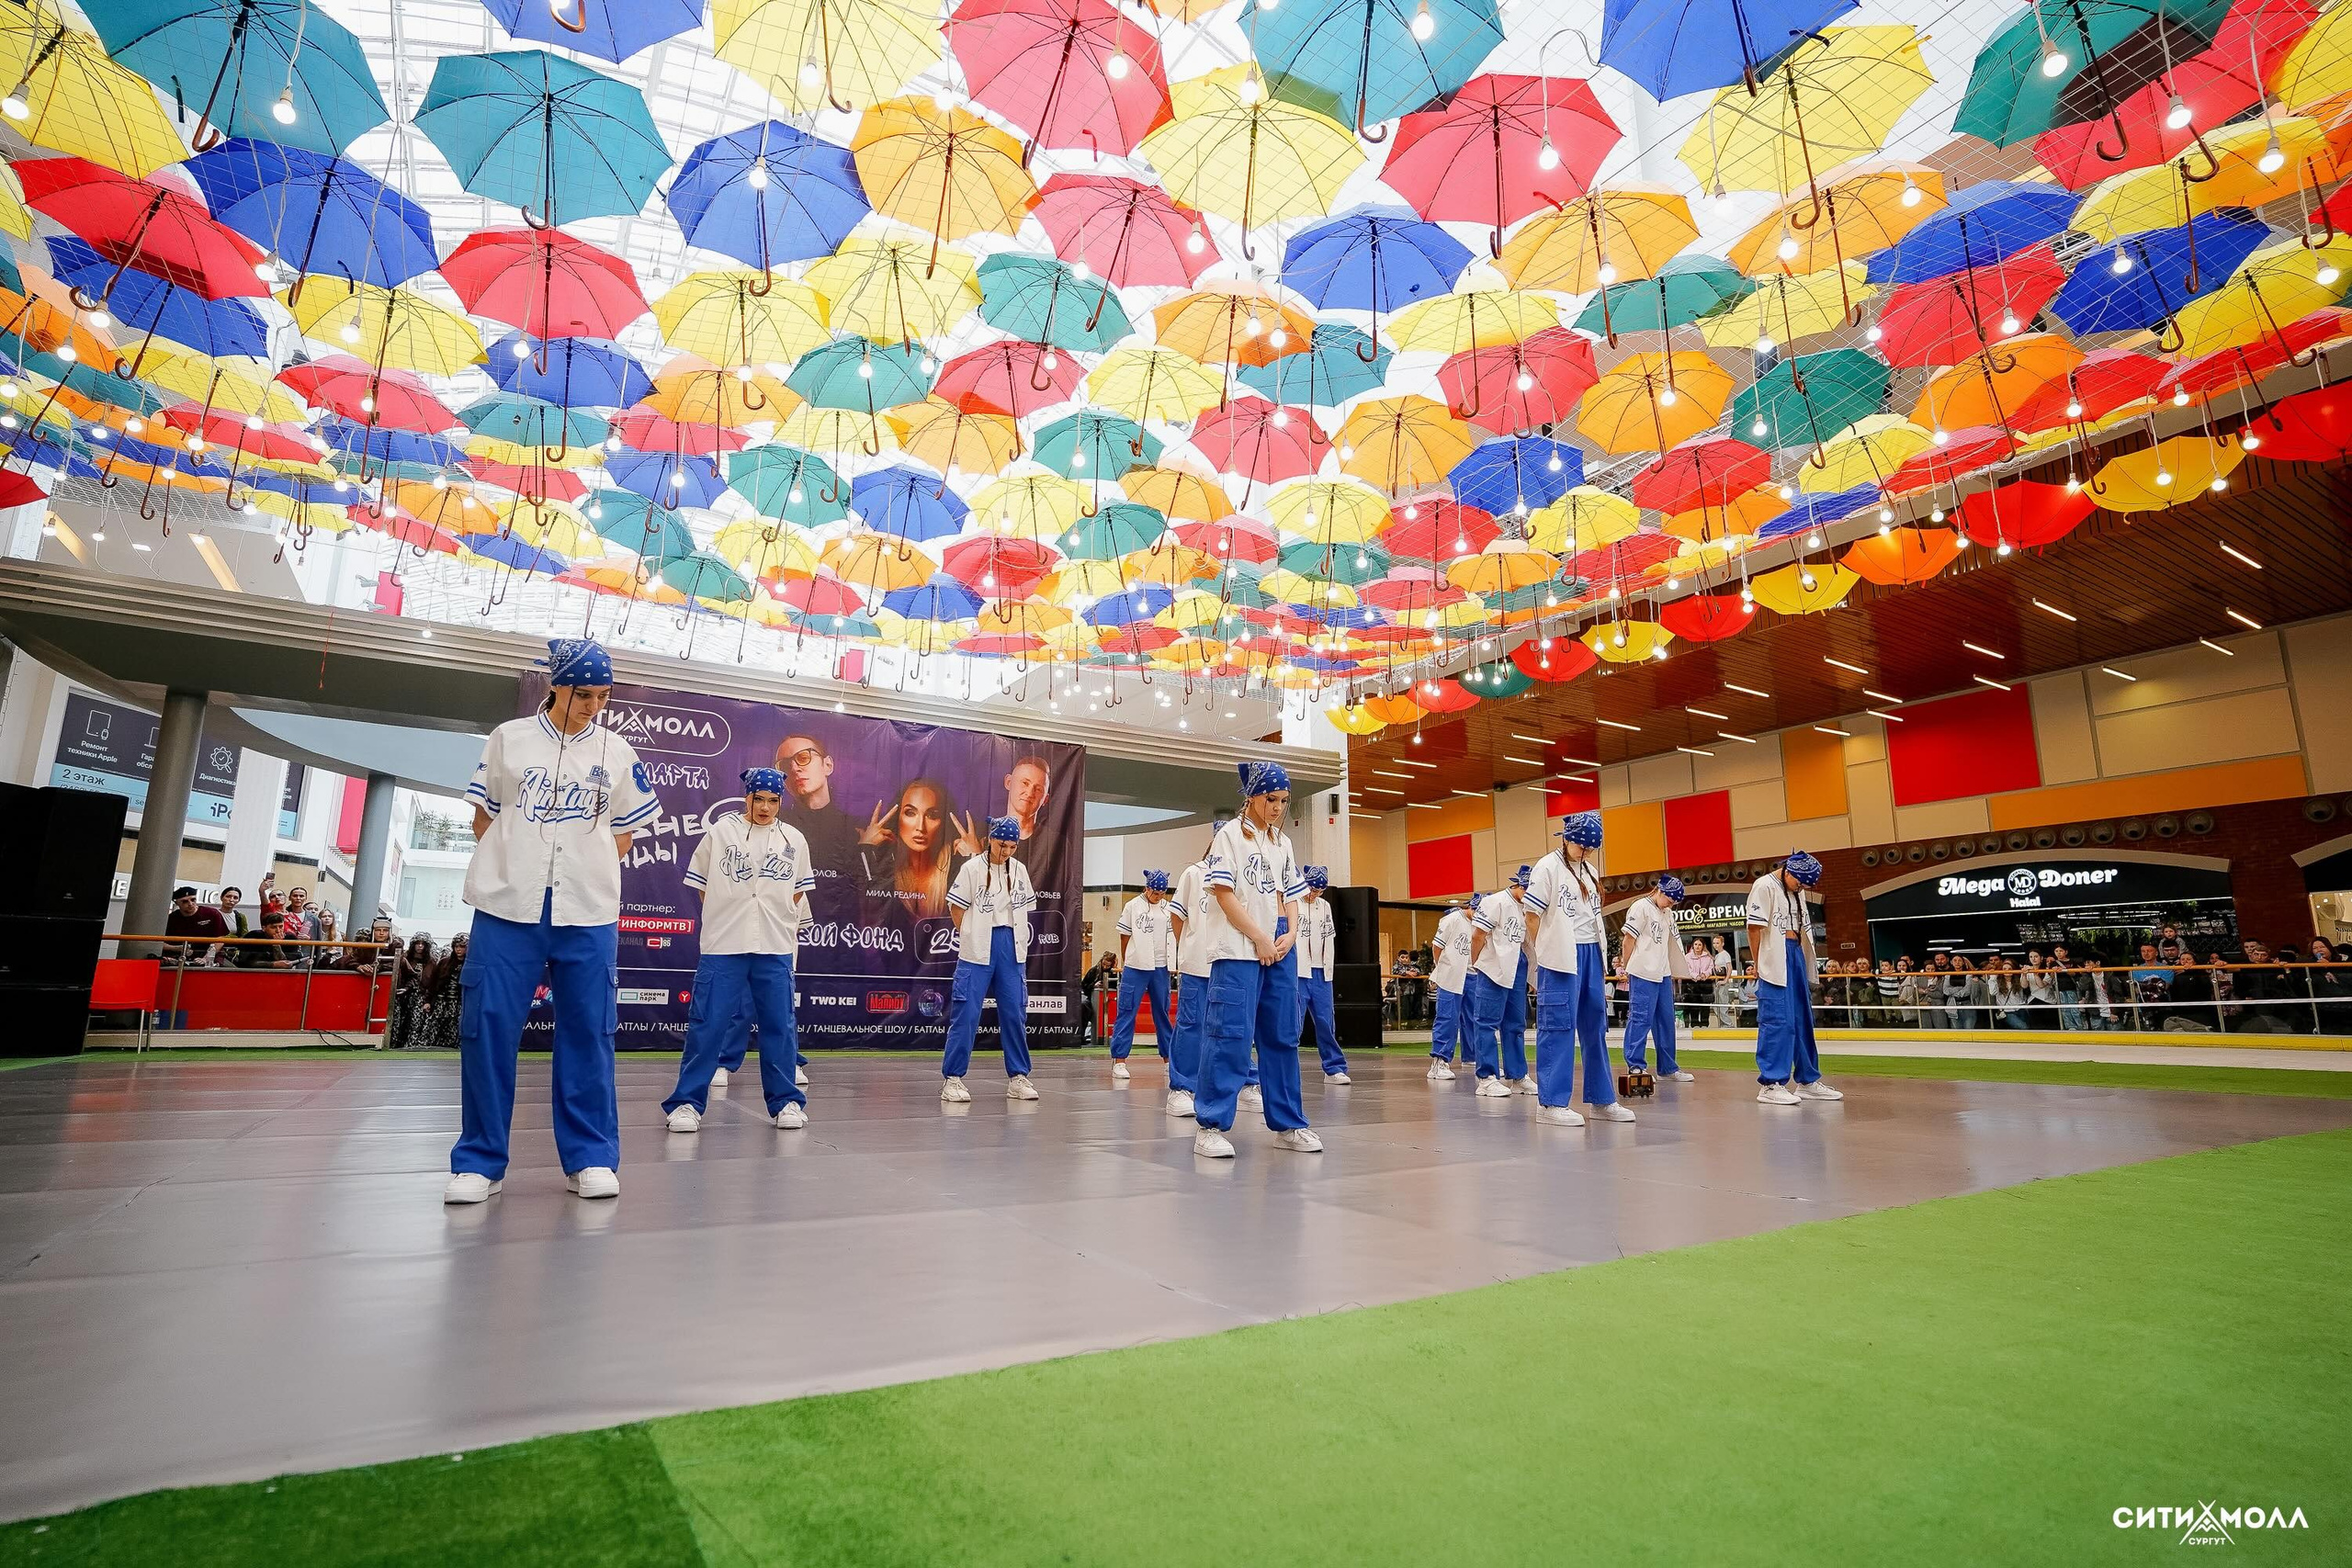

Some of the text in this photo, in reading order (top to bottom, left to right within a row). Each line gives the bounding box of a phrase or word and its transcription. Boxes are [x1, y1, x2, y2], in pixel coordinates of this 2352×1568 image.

[645, 714, 716, 739] МОЛЛ
[81, 740, 108, 752] Ремонт
[67, 747, 119, 763] техники Apple
[62, 769, 106, 786] 2 этаж
[199, 773, 236, 786] Диагностика
[1938, 876, 2006, 897] Mega
[2038, 869, 2118, 888] Doner
[865, 889, 927, 900] МИЛА РЕДИНА
[2009, 896, 2041, 908] Halal
[627, 903, 675, 915] партнер:
[841, 922, 905, 953] ФОНД
[1037, 933, 1060, 945] RUB
[809, 996, 857, 1006] TWO KEI
[1026, 999, 1063, 1009] анлав
[523, 1021, 556, 1030] АЛЬН
[813, 1025, 883, 1034] ТАНЦЕВАЛЬНОЕ
[884, 1025, 906, 1034] ШОУ
[914, 1025, 945, 1034] БАТТЛЫ
[977, 1026, 1001, 1034] ВАЛЬ
[1044, 1026, 1073, 1034] БАТТЛЫ
